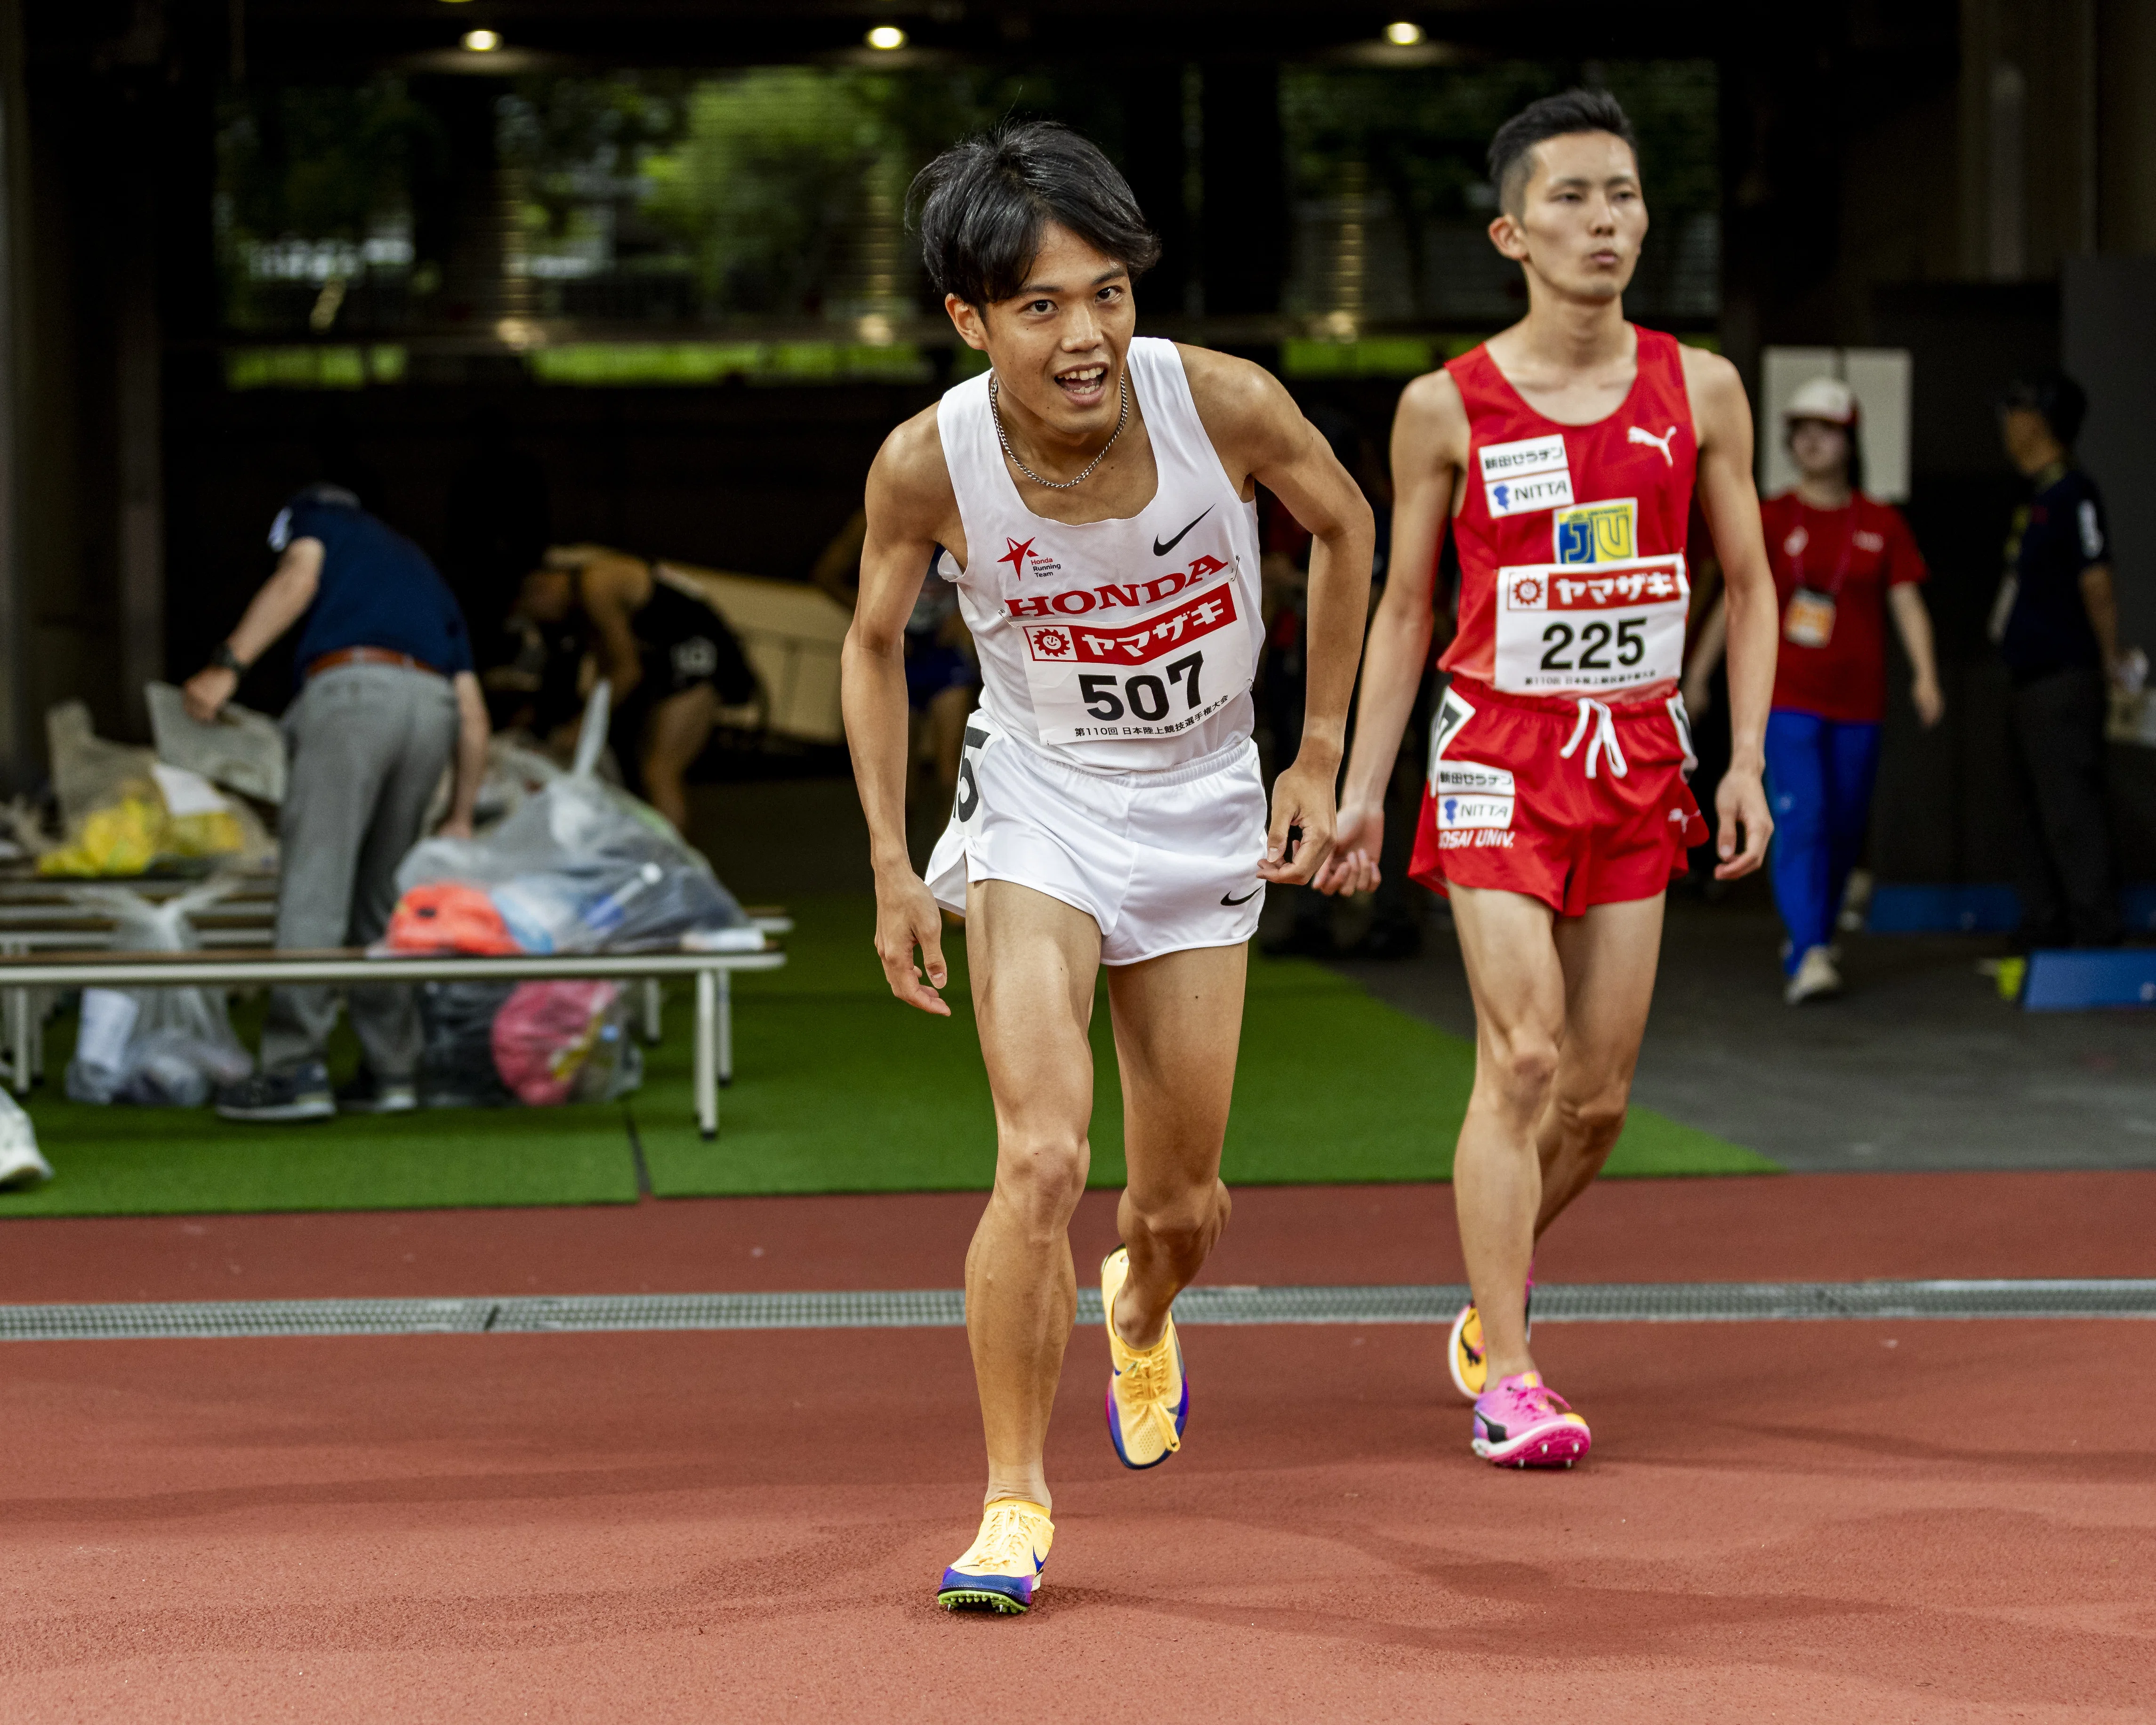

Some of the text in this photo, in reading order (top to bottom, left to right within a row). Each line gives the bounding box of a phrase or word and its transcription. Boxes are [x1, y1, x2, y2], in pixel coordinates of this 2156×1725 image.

[1514, 480, 1568, 501] NITTA
[1005, 555, 1228, 617] HONDA
[1033, 564, 1061, 572] Running
[1555, 572, 1674, 605] ヤマザキ
[1082, 597, 1225, 657] ヤマザキ
[1541, 617, 1648, 671] 225
[1078, 651, 1204, 721] 507
[1075, 694, 1228, 737] 第110回 日本陸上競技選手権大会
[1461, 804, 1509, 818] NITTA
